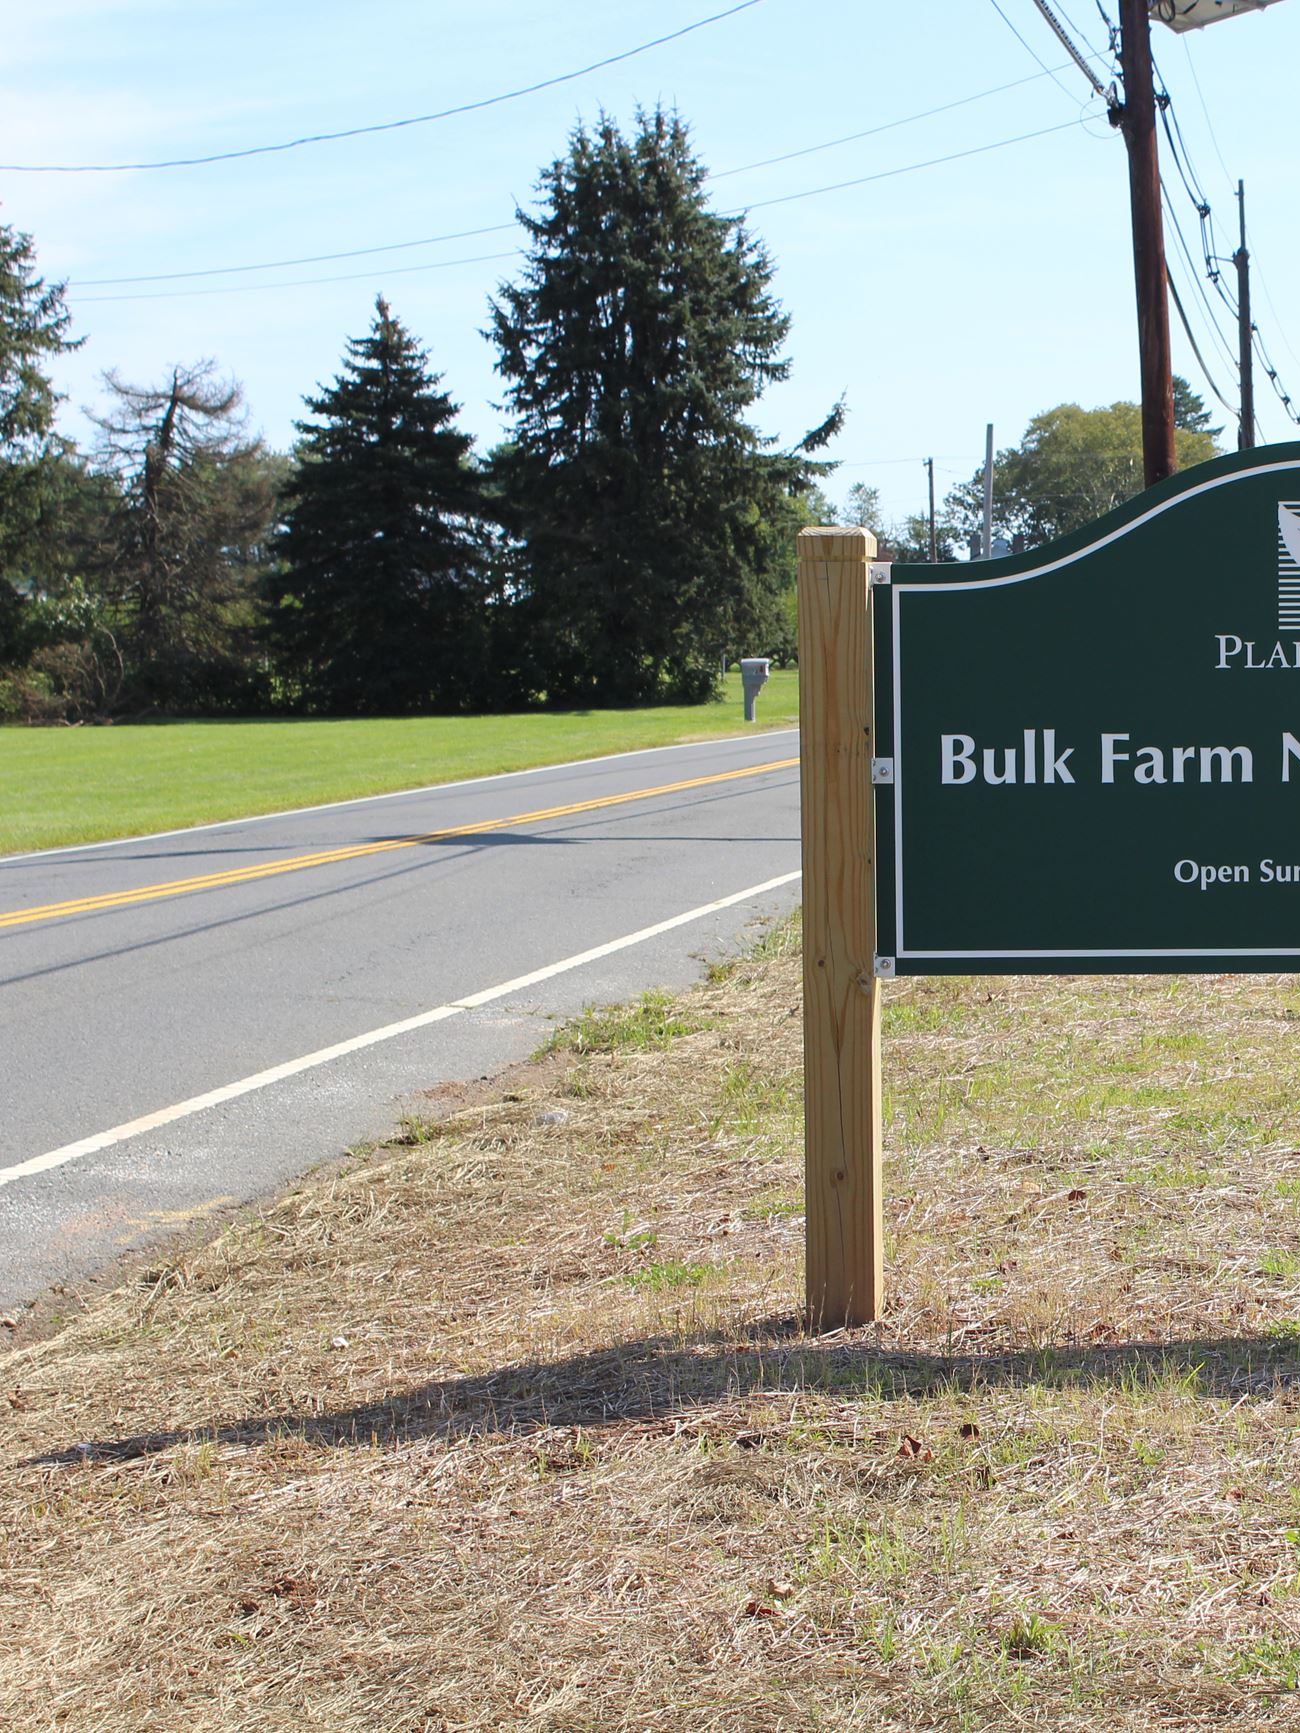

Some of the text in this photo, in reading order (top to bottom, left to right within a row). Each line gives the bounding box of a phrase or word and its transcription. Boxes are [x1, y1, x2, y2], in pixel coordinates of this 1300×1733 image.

[941, 729, 1076, 785] Bulk
[1102, 734, 1253, 783] Farm
[1174, 859, 1250, 890] Open
